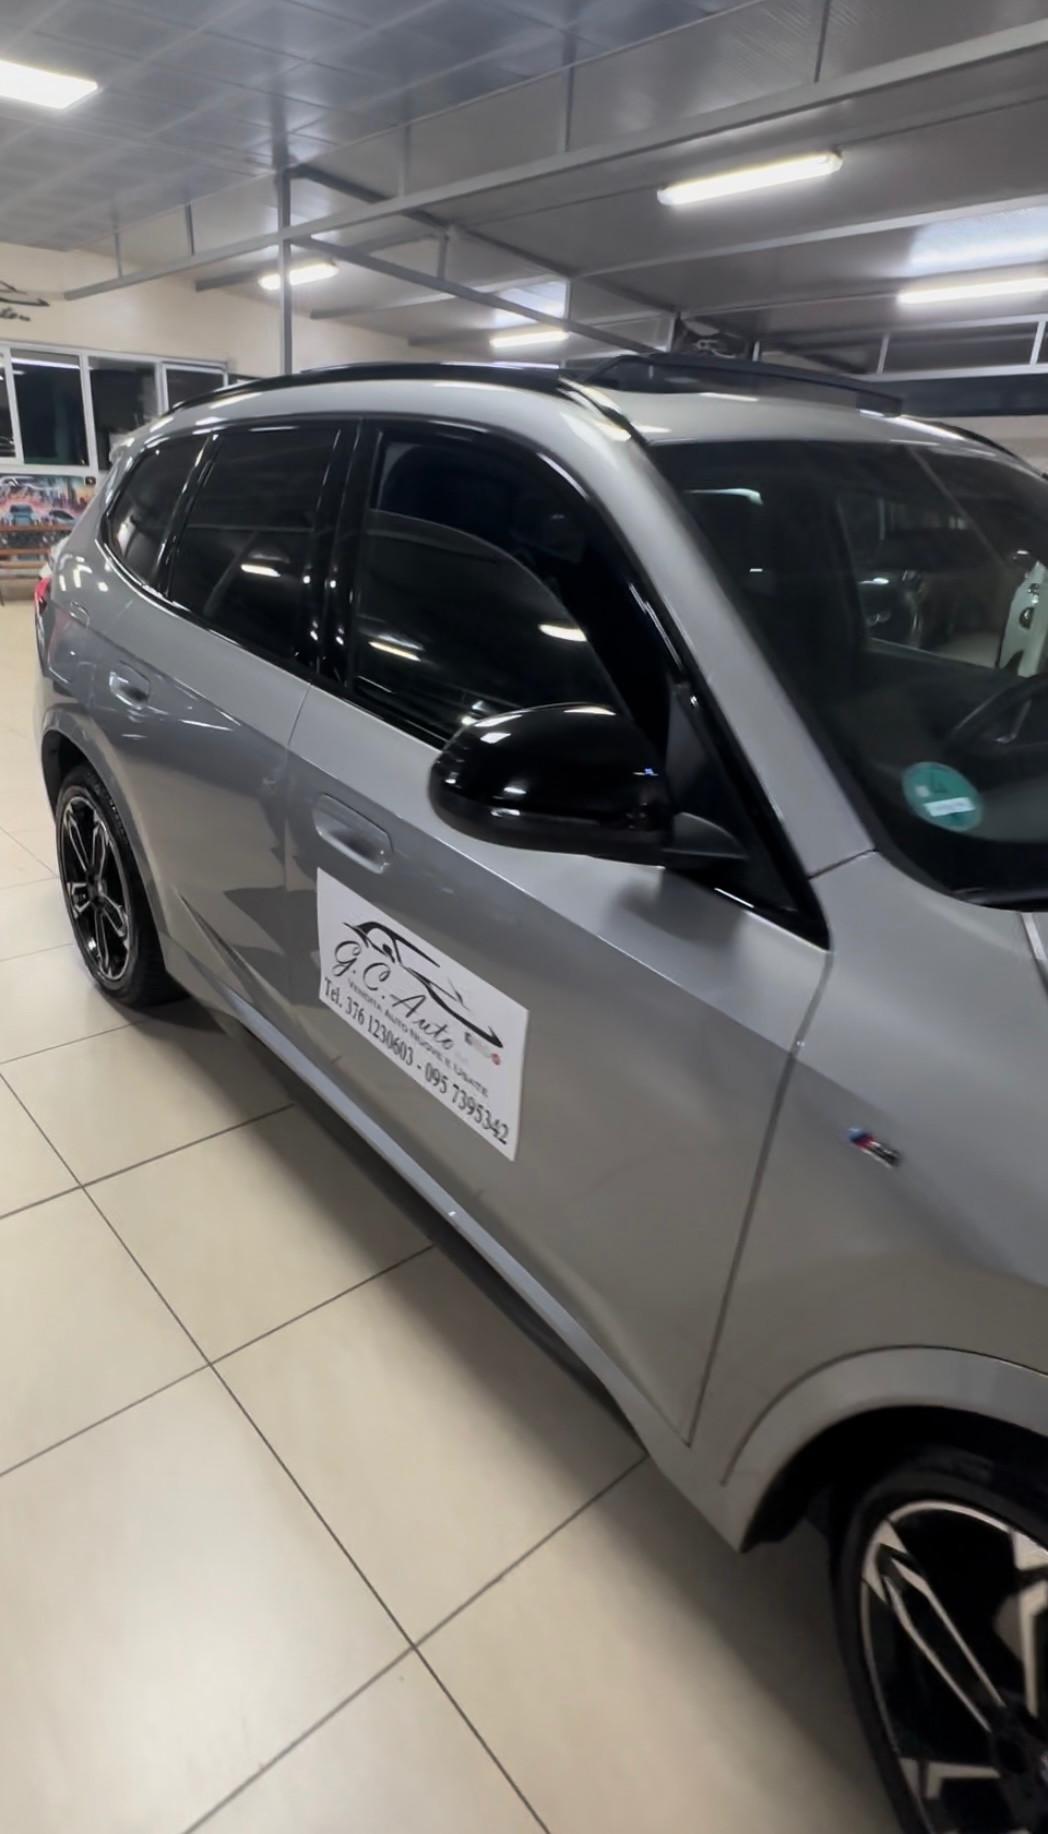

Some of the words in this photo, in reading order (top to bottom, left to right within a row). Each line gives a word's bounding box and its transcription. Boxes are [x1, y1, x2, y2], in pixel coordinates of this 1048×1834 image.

[325, 977, 343, 1008] Tel.
[346, 996, 365, 1025] 376
[424, 1062, 449, 1094] 095
[452, 1083, 509, 1145] 7395342
[389, 994, 454, 1050] Auto
